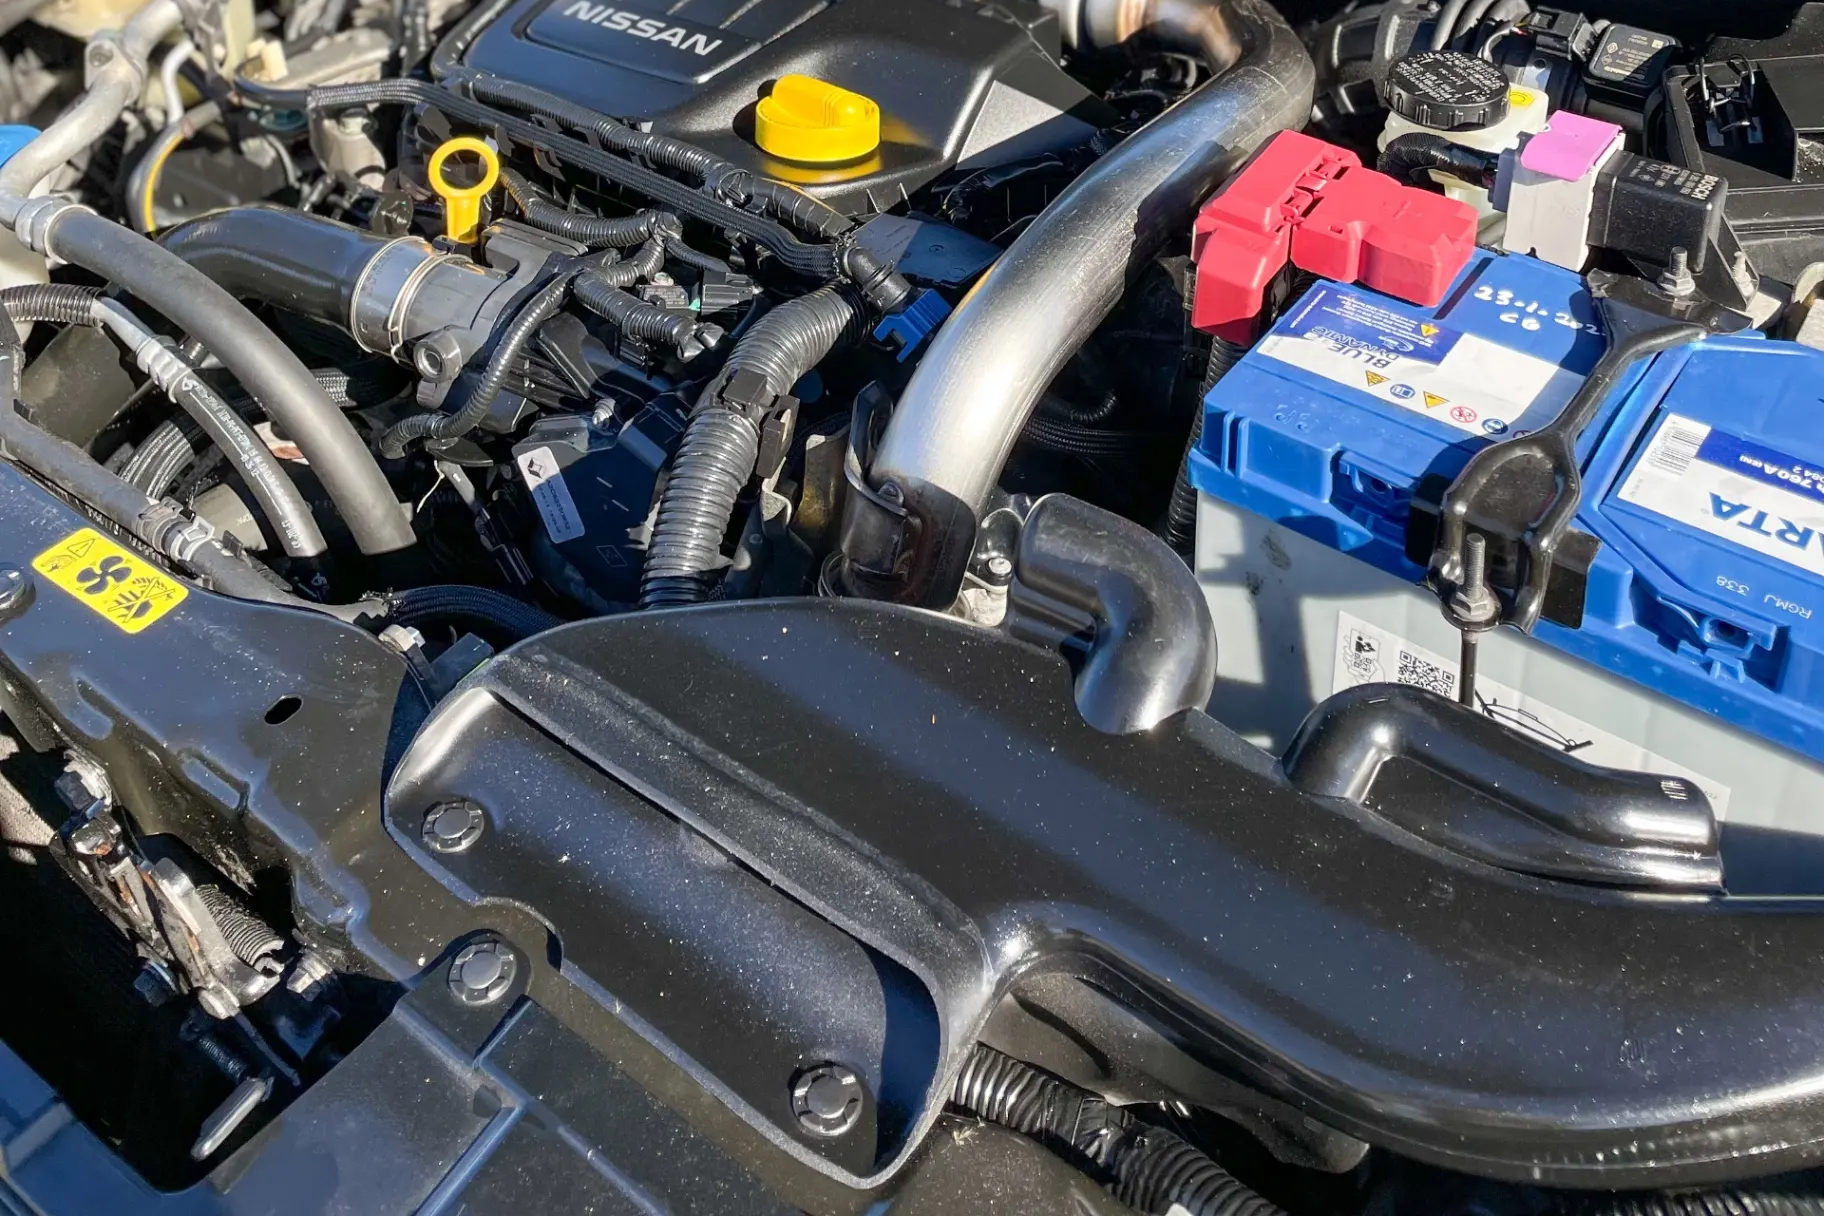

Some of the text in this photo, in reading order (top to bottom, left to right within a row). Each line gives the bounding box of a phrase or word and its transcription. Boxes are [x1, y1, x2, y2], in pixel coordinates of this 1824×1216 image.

[563, 0, 723, 56] NISSAN
[1691, 174, 1719, 200] BOSCH
[1328, 343, 1391, 369] BLUE
[1709, 492, 1824, 558] RTA
[1716, 575, 1813, 619] RGMJ 338
